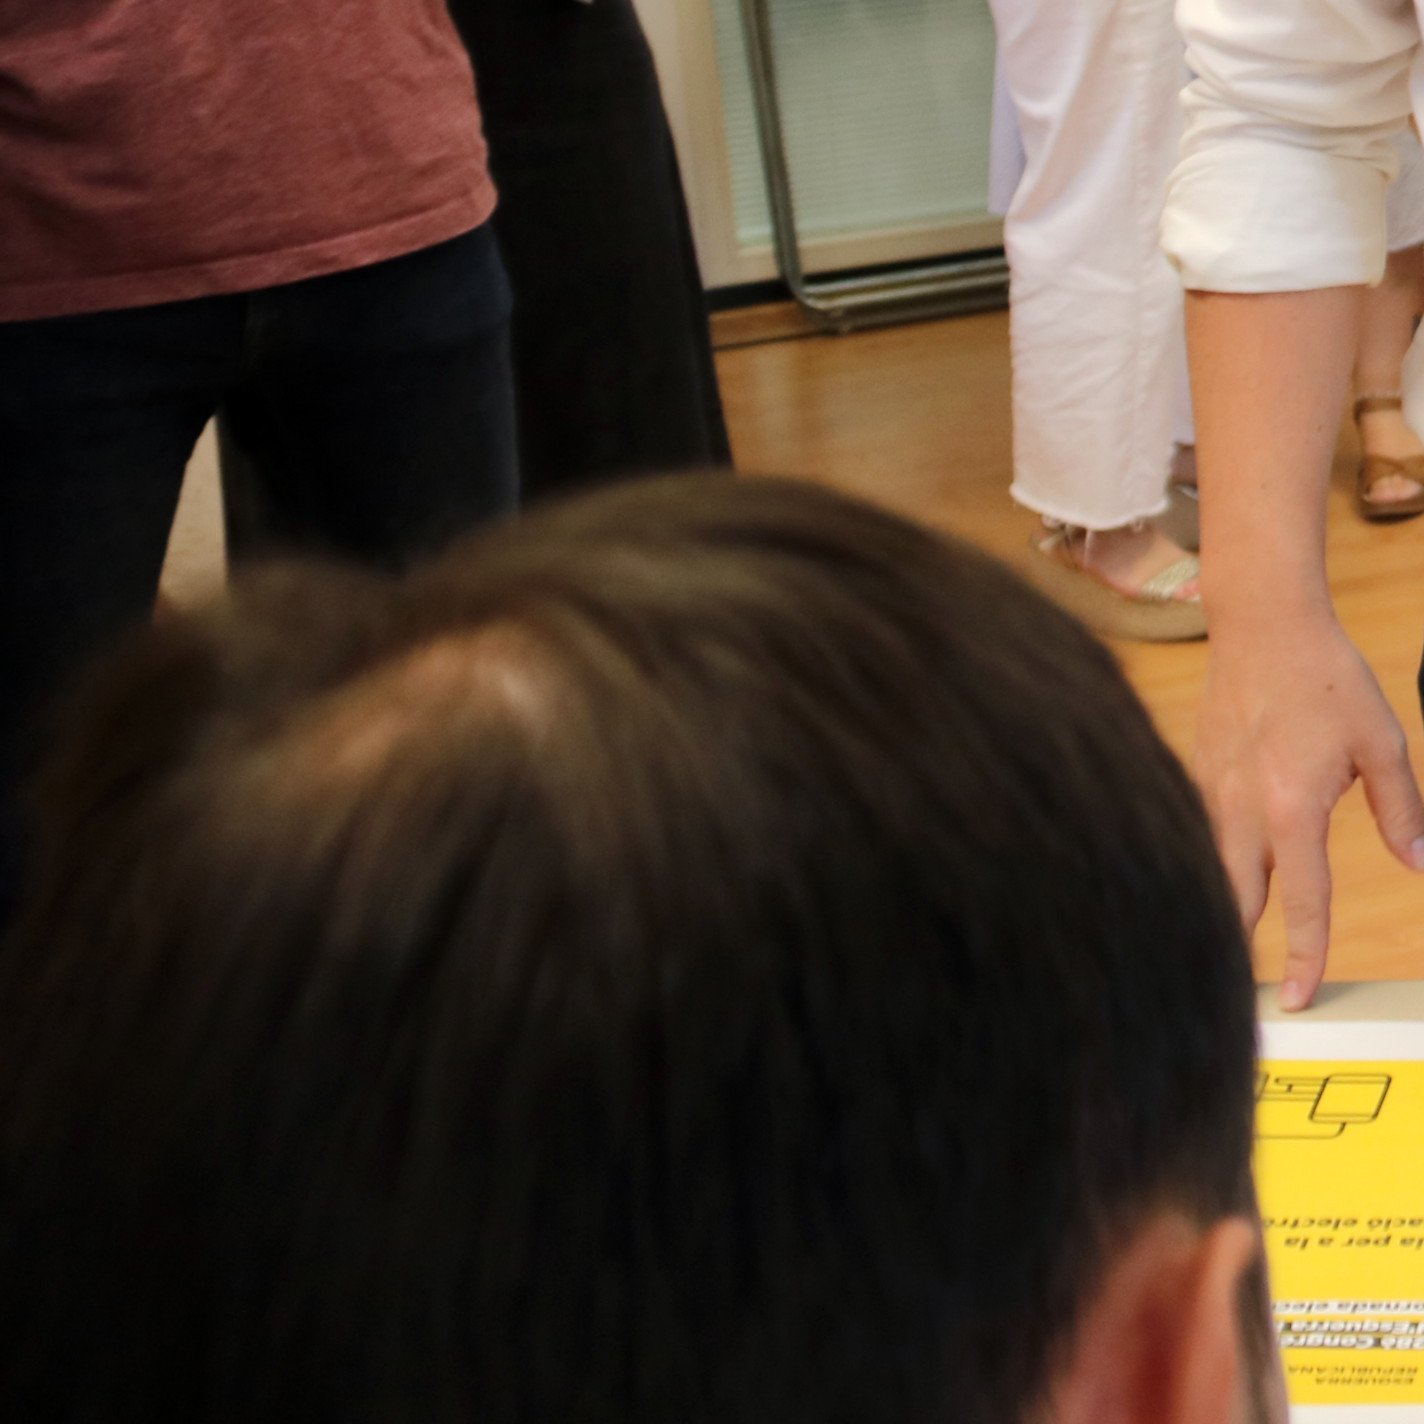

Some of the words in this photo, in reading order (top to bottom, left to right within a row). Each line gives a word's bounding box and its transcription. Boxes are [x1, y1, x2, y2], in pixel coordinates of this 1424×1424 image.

[1285, 1237, 1309, 1249] la
[1317, 1237, 1334, 1248] a
[1345, 1235, 1391, 1248] per
[1279, 1333, 1375, 1350] Congré
[1287, 1365, 1419, 1375] REPUBLICANA
